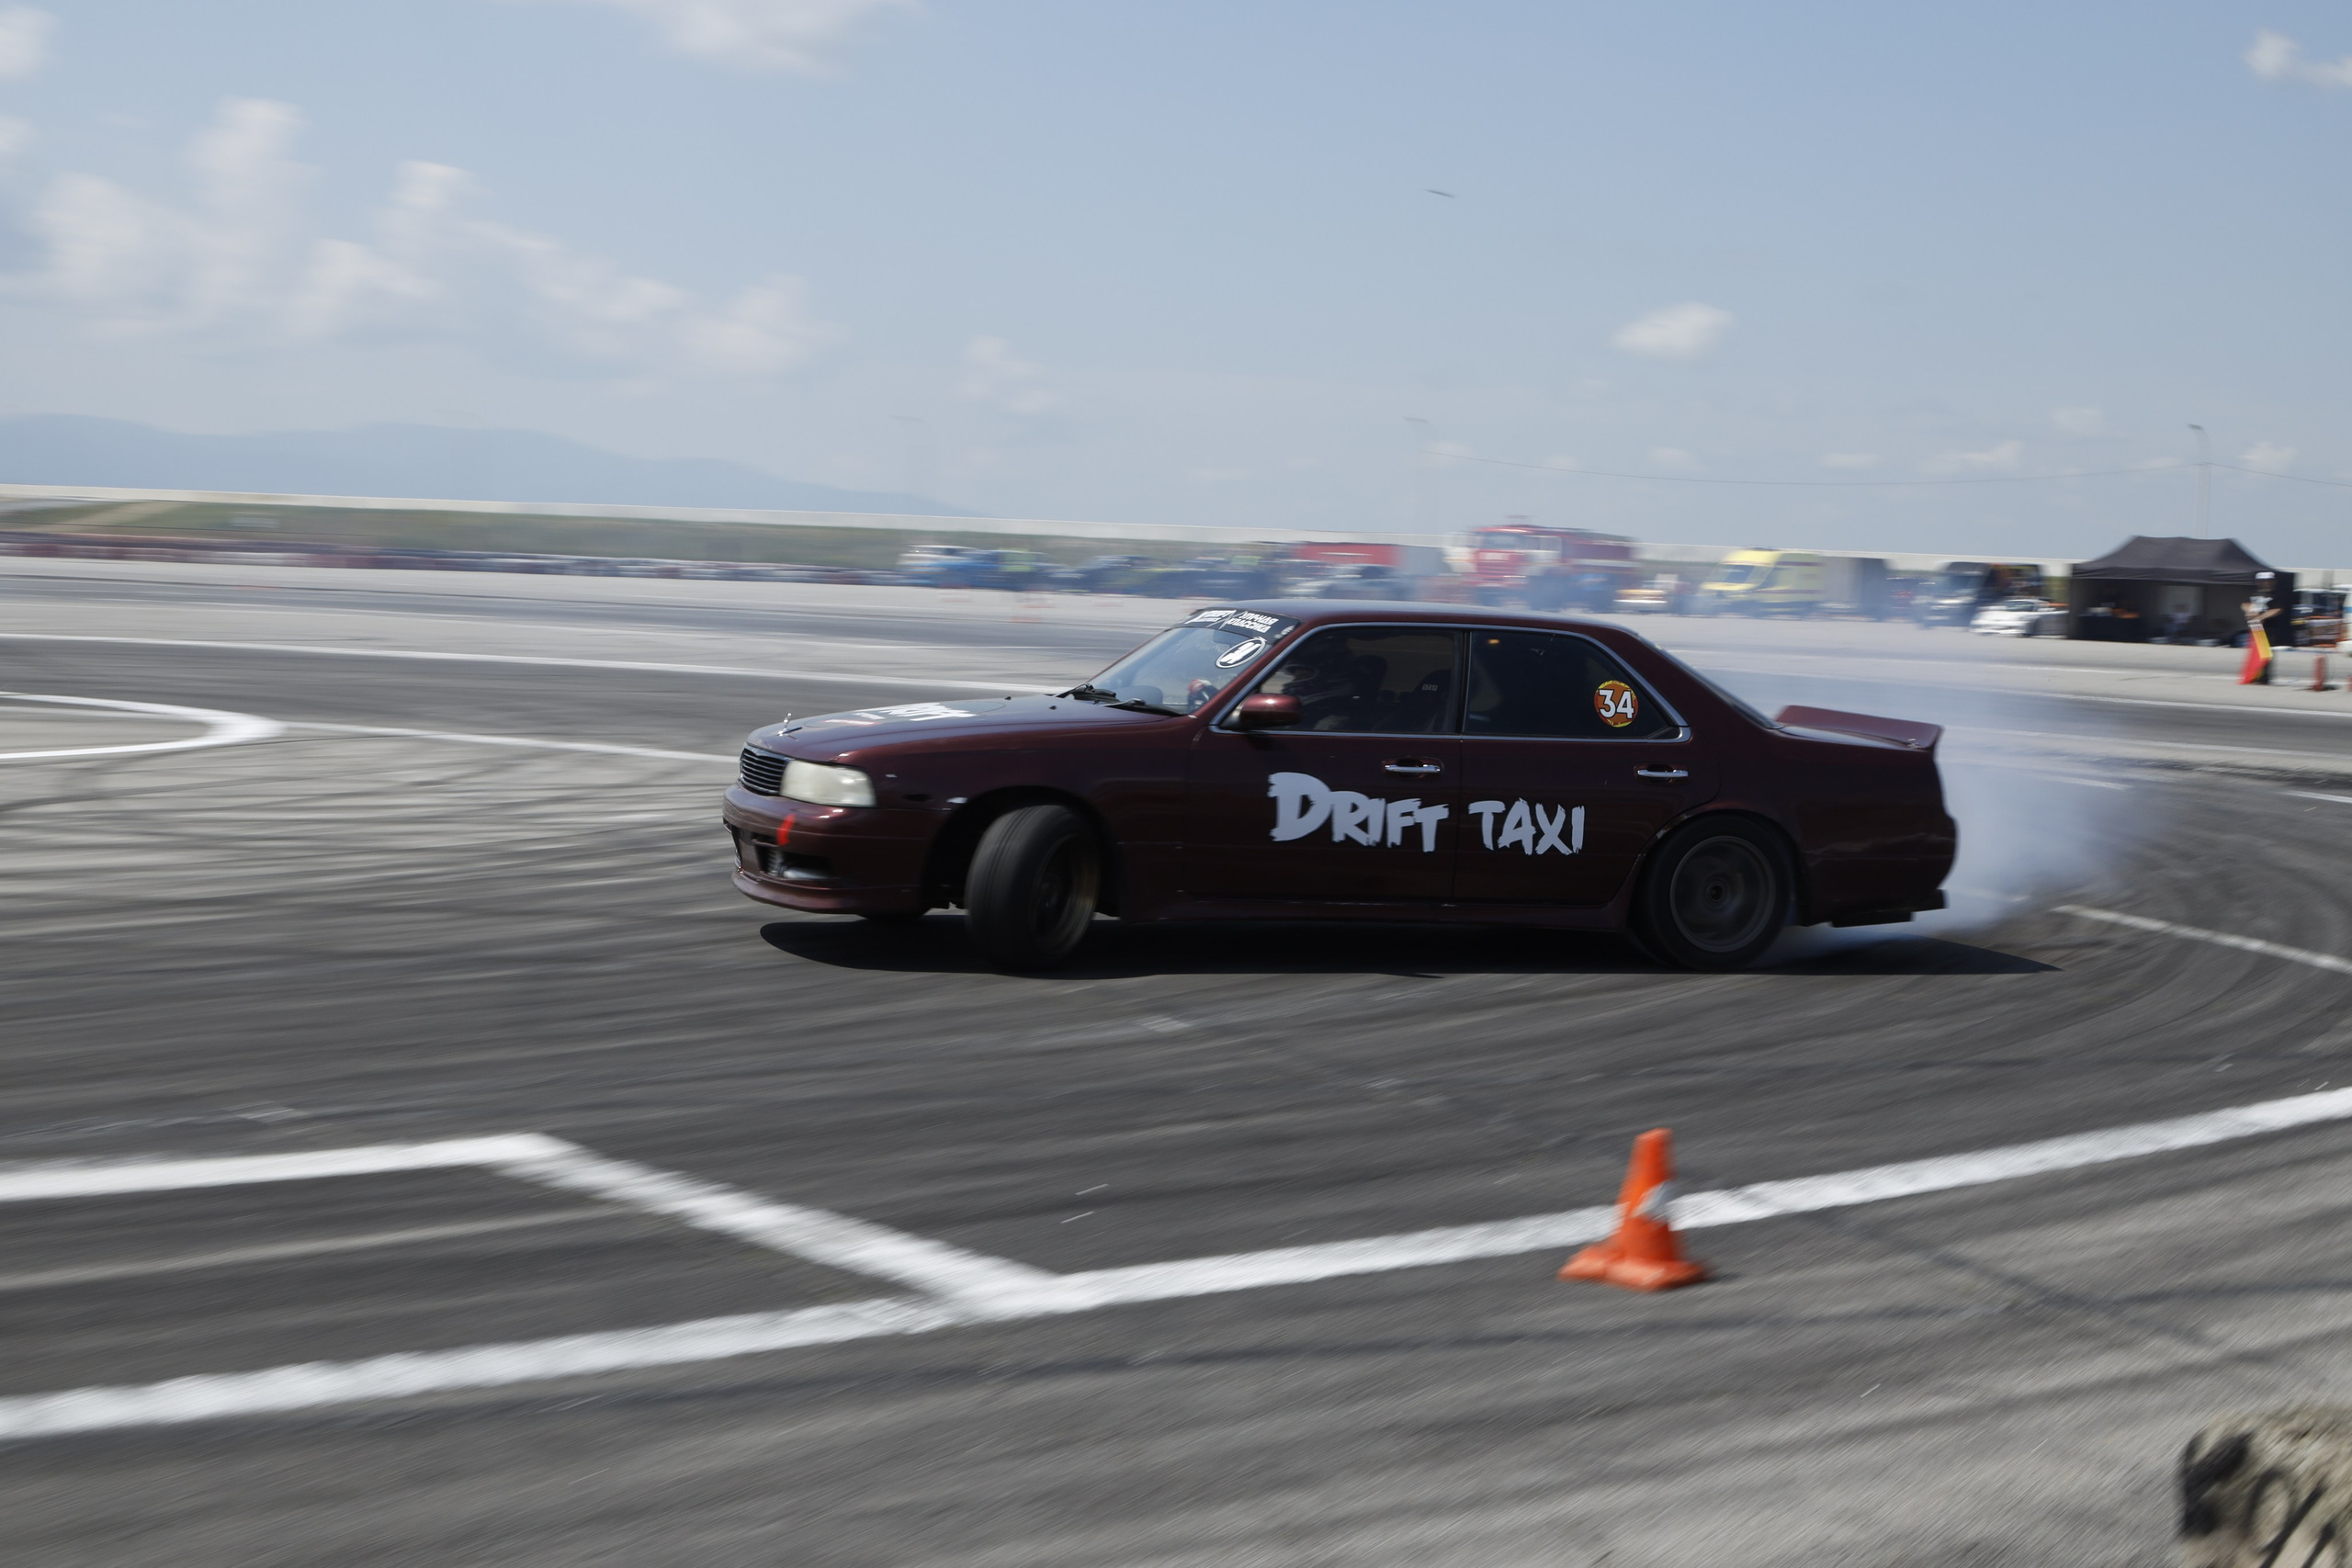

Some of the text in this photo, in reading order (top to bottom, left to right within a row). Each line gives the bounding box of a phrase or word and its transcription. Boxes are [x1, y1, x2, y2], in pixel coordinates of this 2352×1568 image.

[1599, 689, 1634, 719] 34
[1267, 772, 1585, 855] DRIFT TAXI
